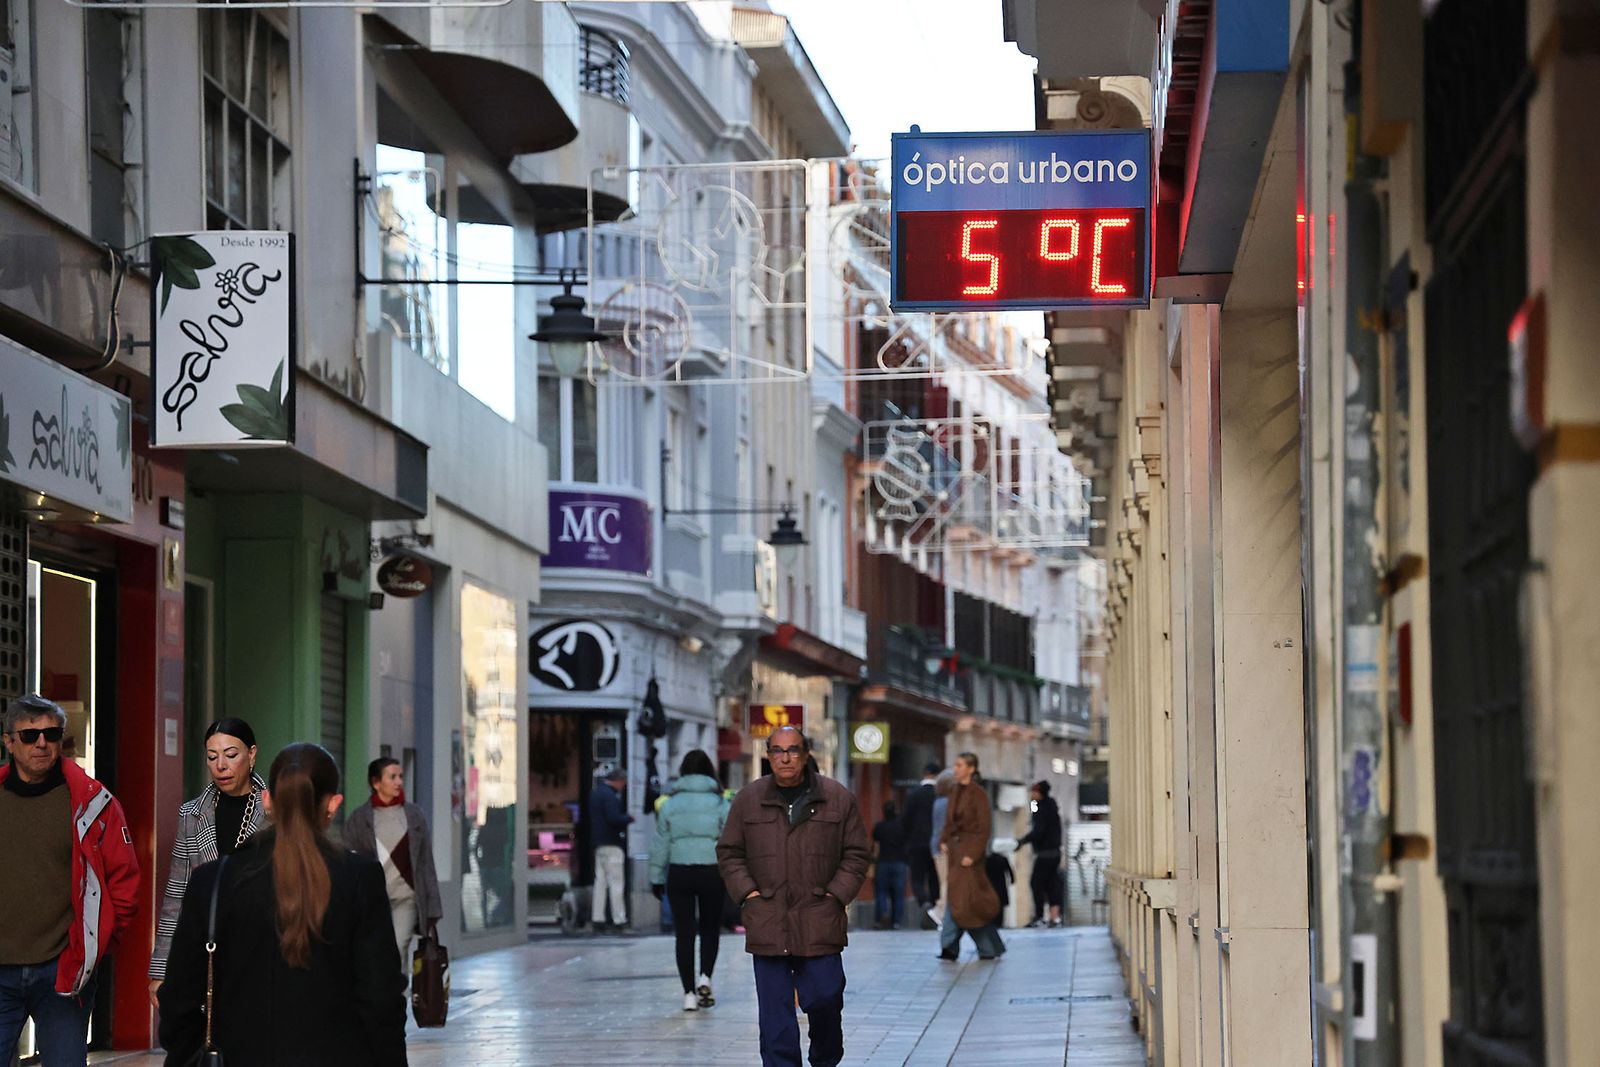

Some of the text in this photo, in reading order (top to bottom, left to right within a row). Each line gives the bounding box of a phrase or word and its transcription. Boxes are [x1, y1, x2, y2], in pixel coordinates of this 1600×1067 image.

[903, 152, 1137, 192] óptica urbano
[220, 235, 286, 249] Desde 1992
[961, 219, 999, 295] 5
[558, 504, 622, 544] MC
